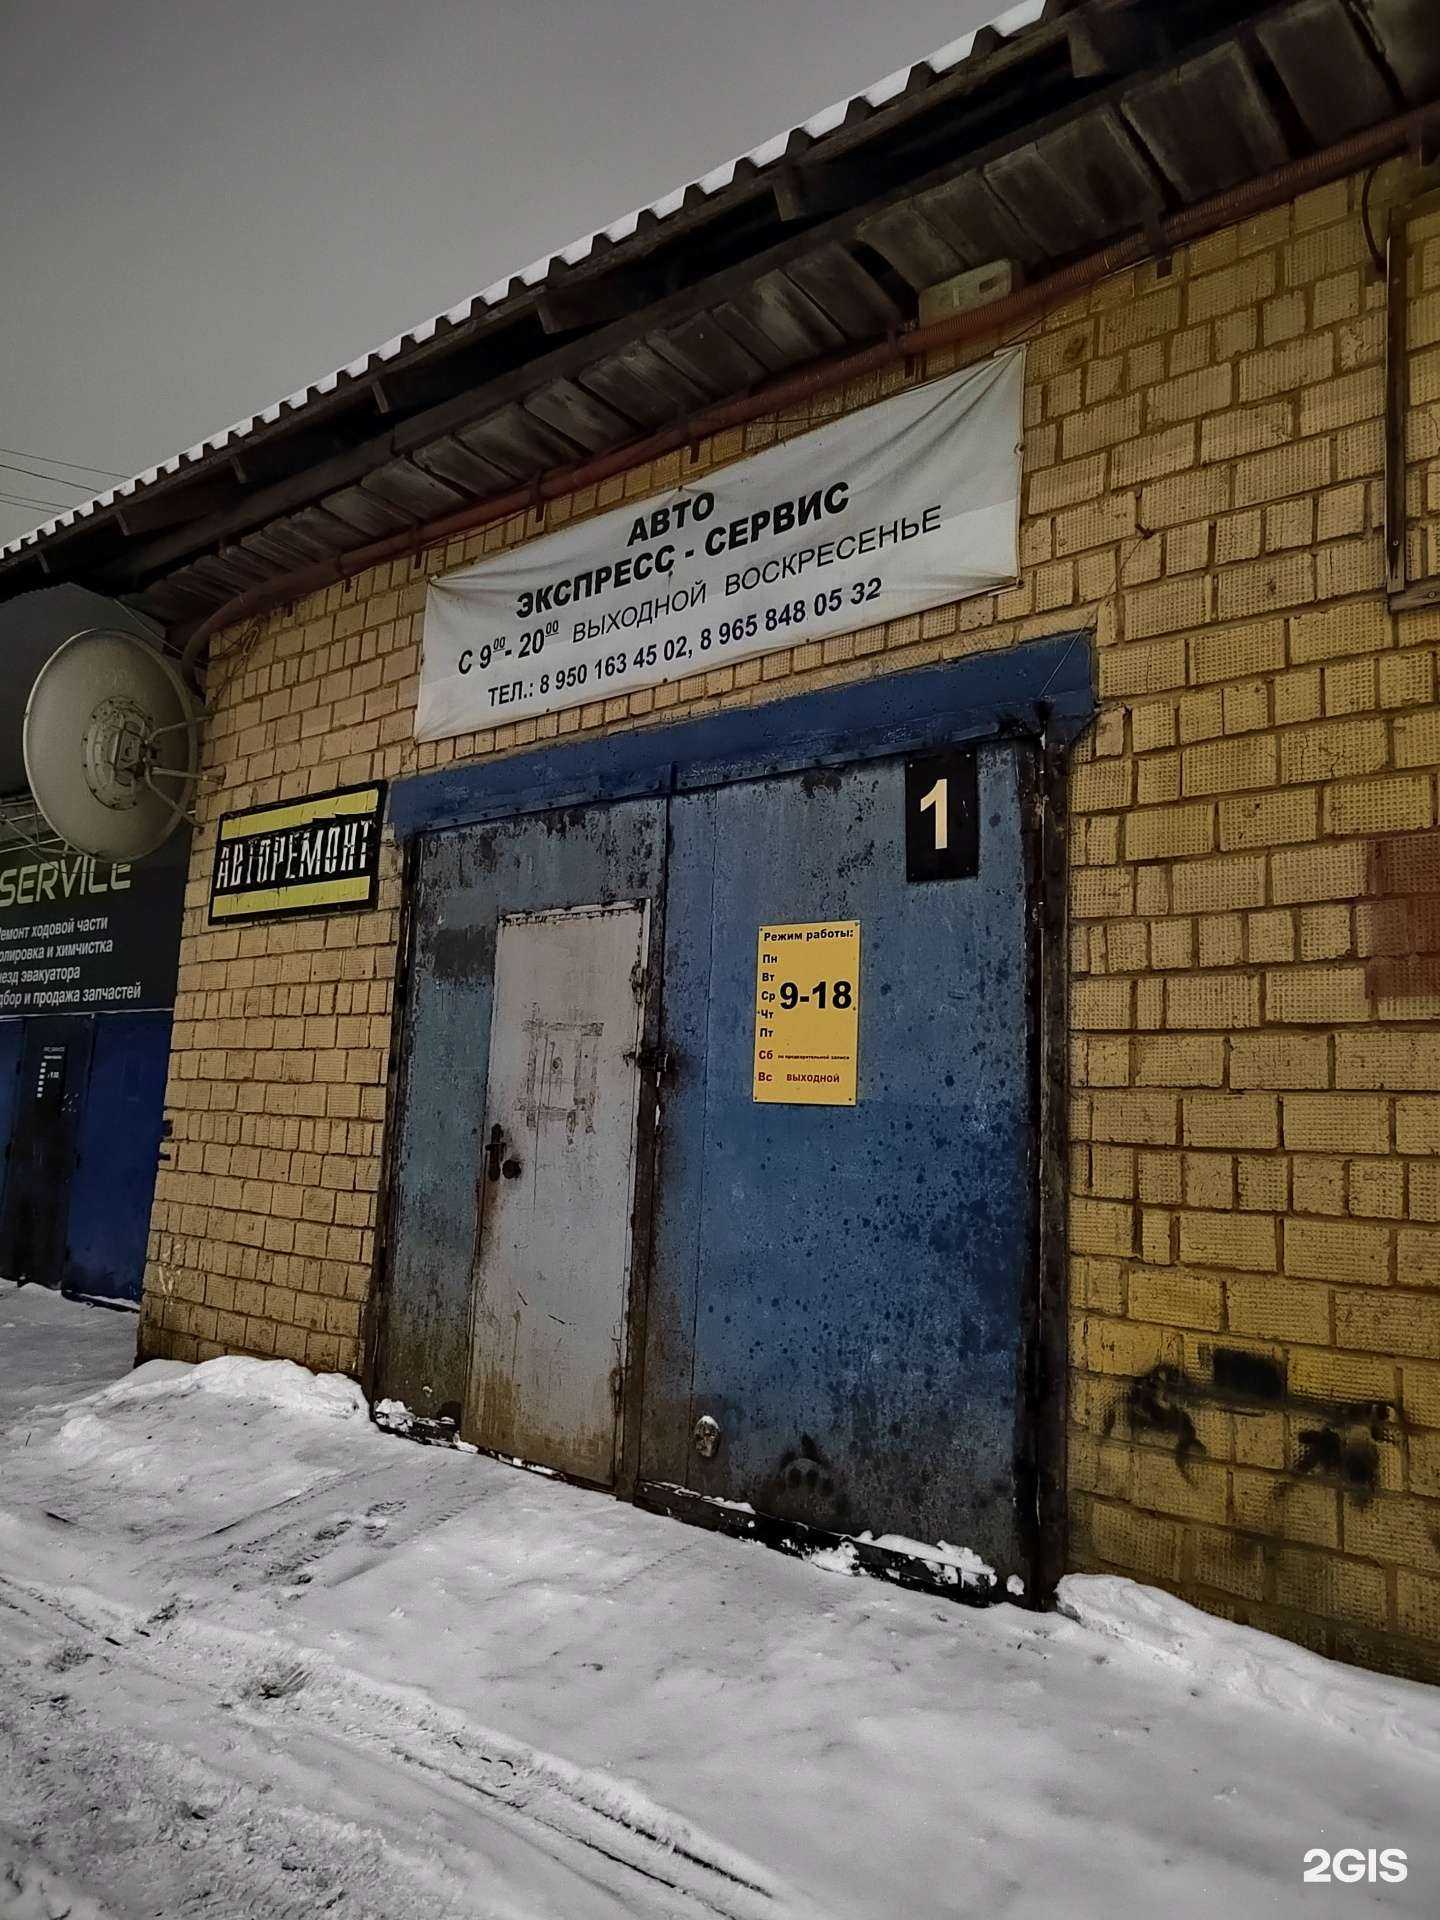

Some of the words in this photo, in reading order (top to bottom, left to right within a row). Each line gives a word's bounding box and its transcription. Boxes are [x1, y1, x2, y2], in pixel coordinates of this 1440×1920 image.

[627, 492, 715, 547] АВТО
[516, 544, 675, 618] ЭКСПРЕСС
[704, 482, 849, 556] СЕРВИС
[458, 650, 473, 675] С
[572, 579, 707, 643] ВЫХОДНОЙ
[725, 505, 942, 596] ВОСКРЕСЕНЬЕ
[488, 681, 533, 707] ТЕЛ.:
[540, 674, 550, 694] 8
[555, 664, 588, 690] 950
[594, 652, 627, 680] 163
[633, 644, 657, 669] 45
[663, 635, 693, 661] 02,
[700, 628, 712, 651] 8
[718, 614, 757, 645] 965
[765, 599, 806, 631] 848
[814, 588, 842, 617] 05
[850, 577, 882, 605] 32
[920, 779, 948, 850] 1
[215, 820, 374, 889] АВТОРЕМОНТ
[0, 926, 29, 941] емонт
[31, 918, 74, 939] ходовой
[77, 917, 108, 931] части
[764, 932, 803, 942] Режим
[806, 928, 854, 942] работы:
[47, 945, 53, 958] и
[55, 939, 113, 957] химчистка
[762, 954, 778, 964] Пн
[21, 966, 80, 985] эвакуатора
[762, 972, 775, 982] Вт
[24, 992, 31, 1005] и
[33, 988, 80, 1007] продажа
[83, 981, 141, 1002] запчастей
[761, 991, 776, 1003] Ср
[779, 980, 852, 1010] 9-18
[761, 1009, 774, 1019] Чт
[760, 1028, 774, 1038] Пт
[758, 1050, 774, 1060] Сб
[758, 1072, 773, 1082] Вс
[786, 1073, 841, 1083] выходной
